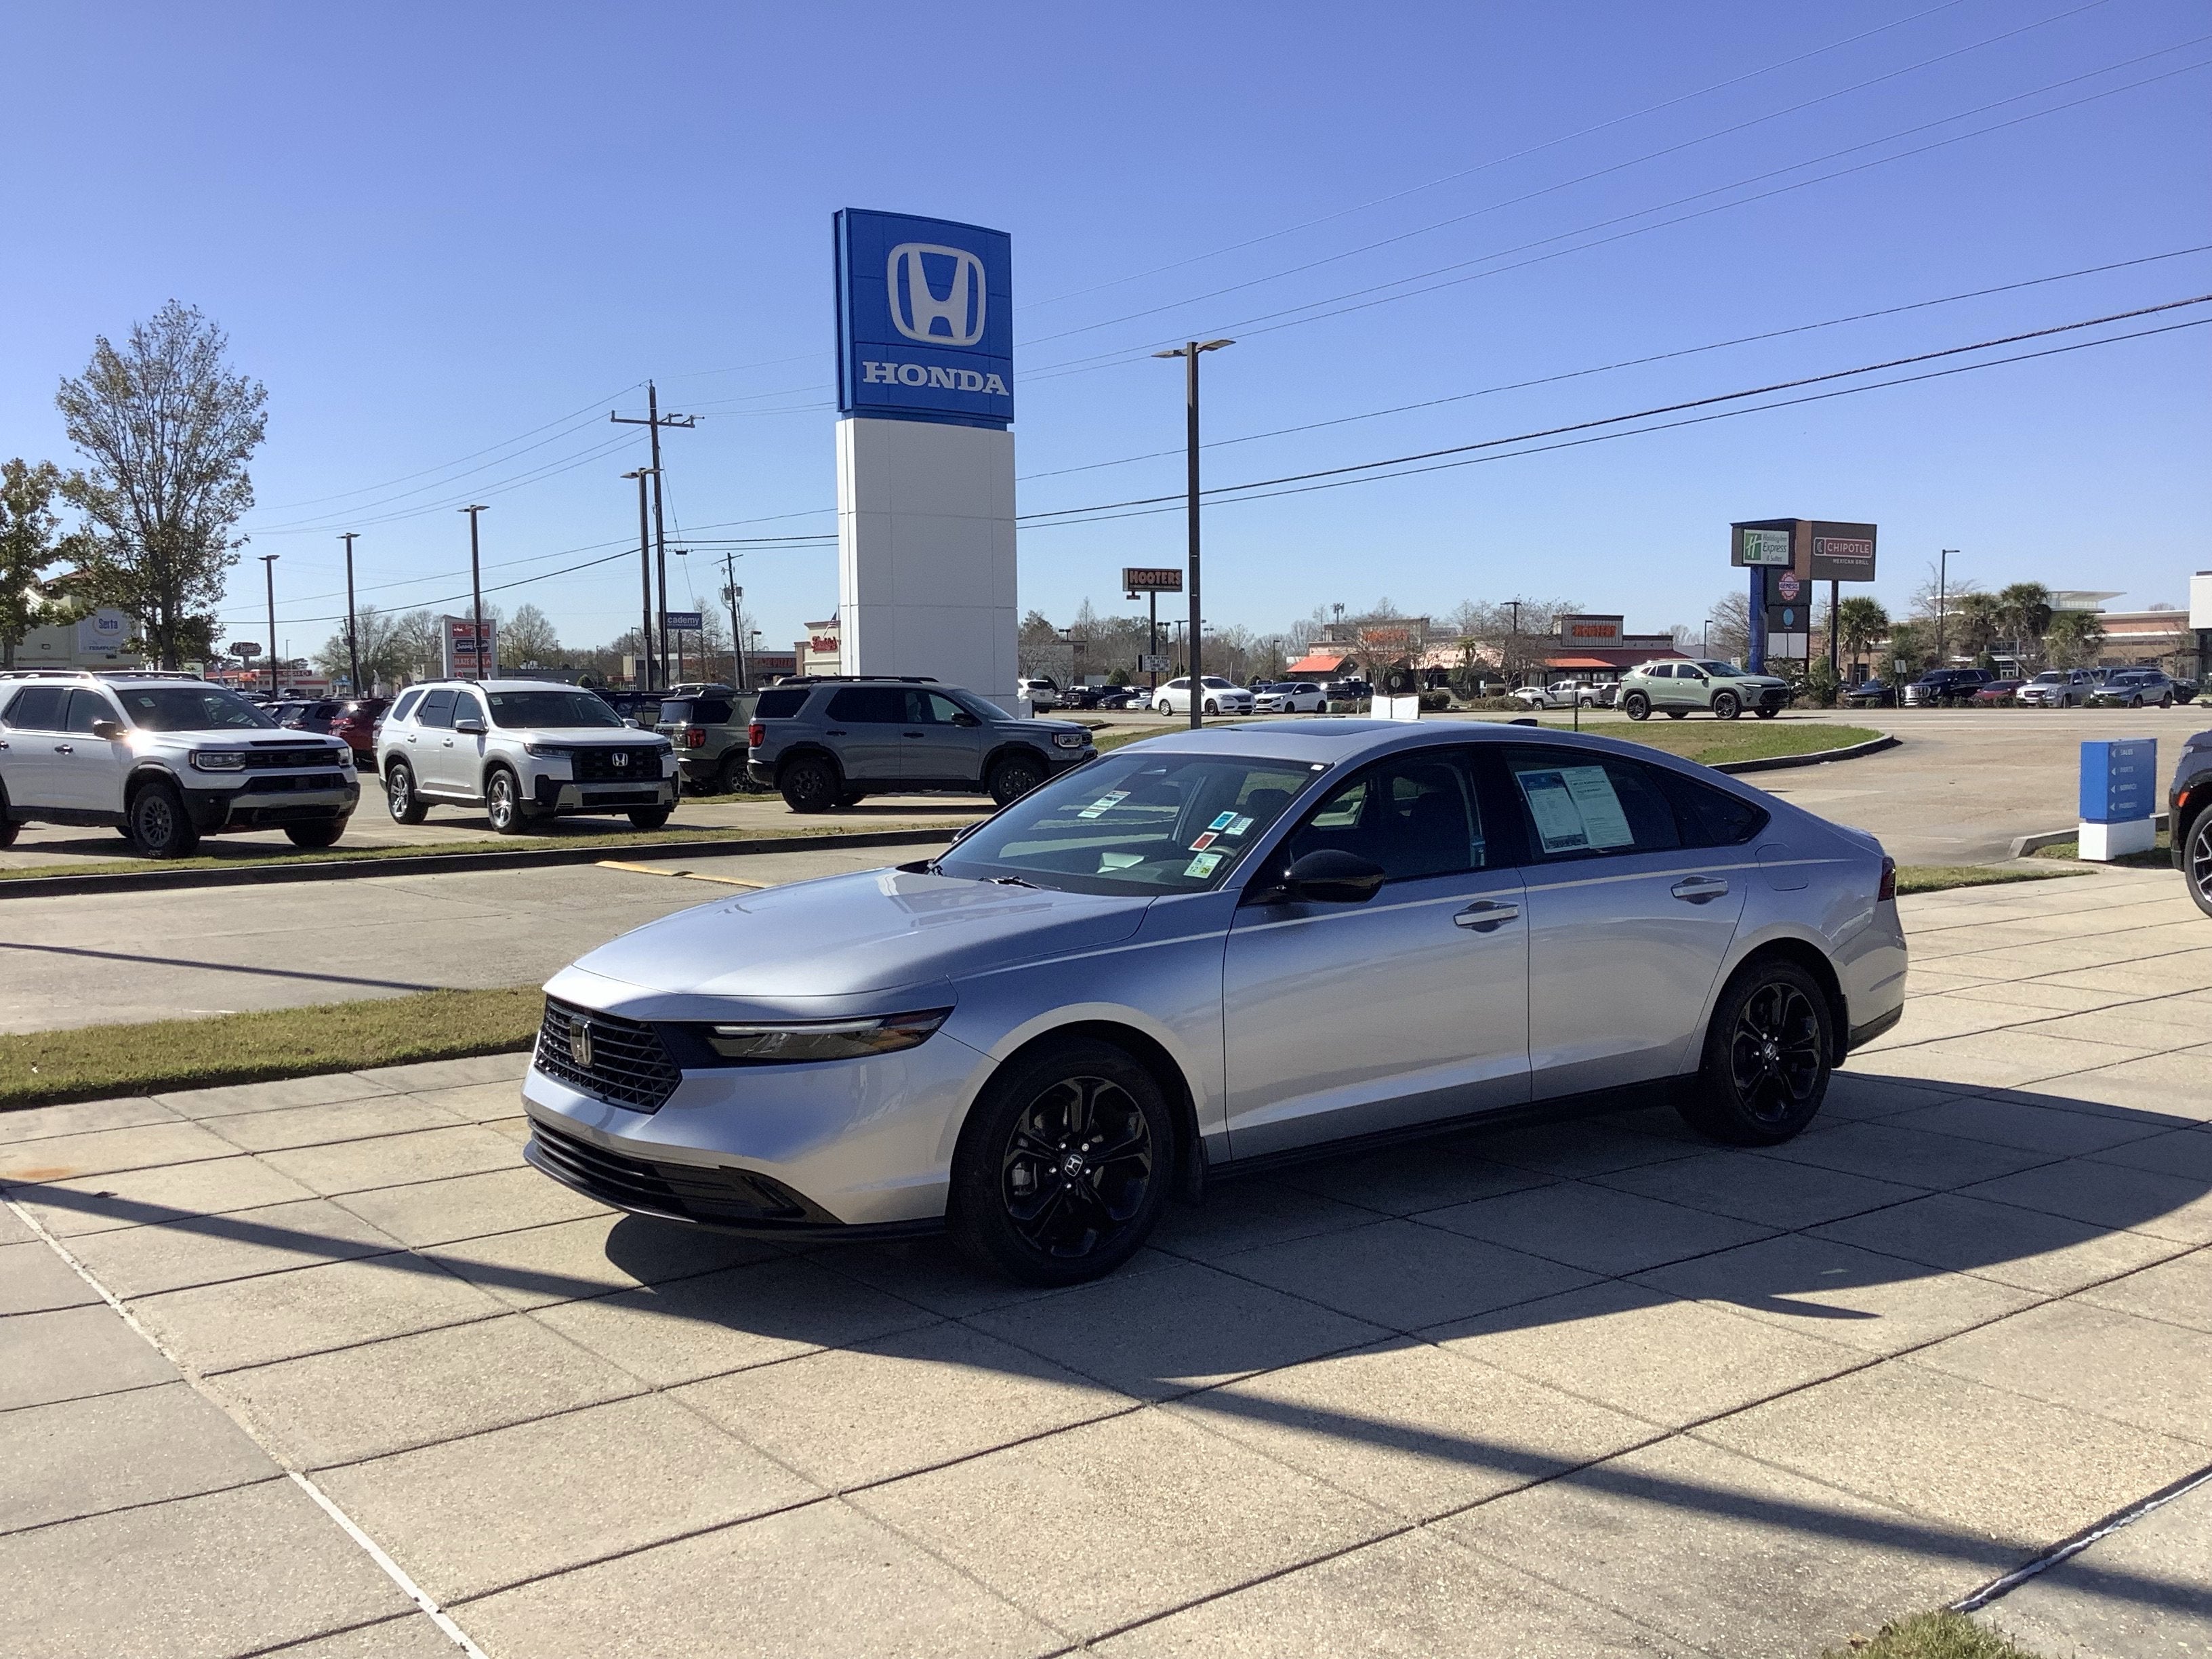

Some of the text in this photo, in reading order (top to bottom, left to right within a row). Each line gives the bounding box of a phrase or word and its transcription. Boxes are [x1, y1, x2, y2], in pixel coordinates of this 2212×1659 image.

[862, 361, 1010, 397] HONDA
[1763, 542, 1786, 554] Express
[1827, 542, 1870, 553] CHIPOTLE
[1129, 571, 1182, 585] HOOTERS
[98, 618, 119, 630] Serta
[667, 616, 699, 626] cademy
